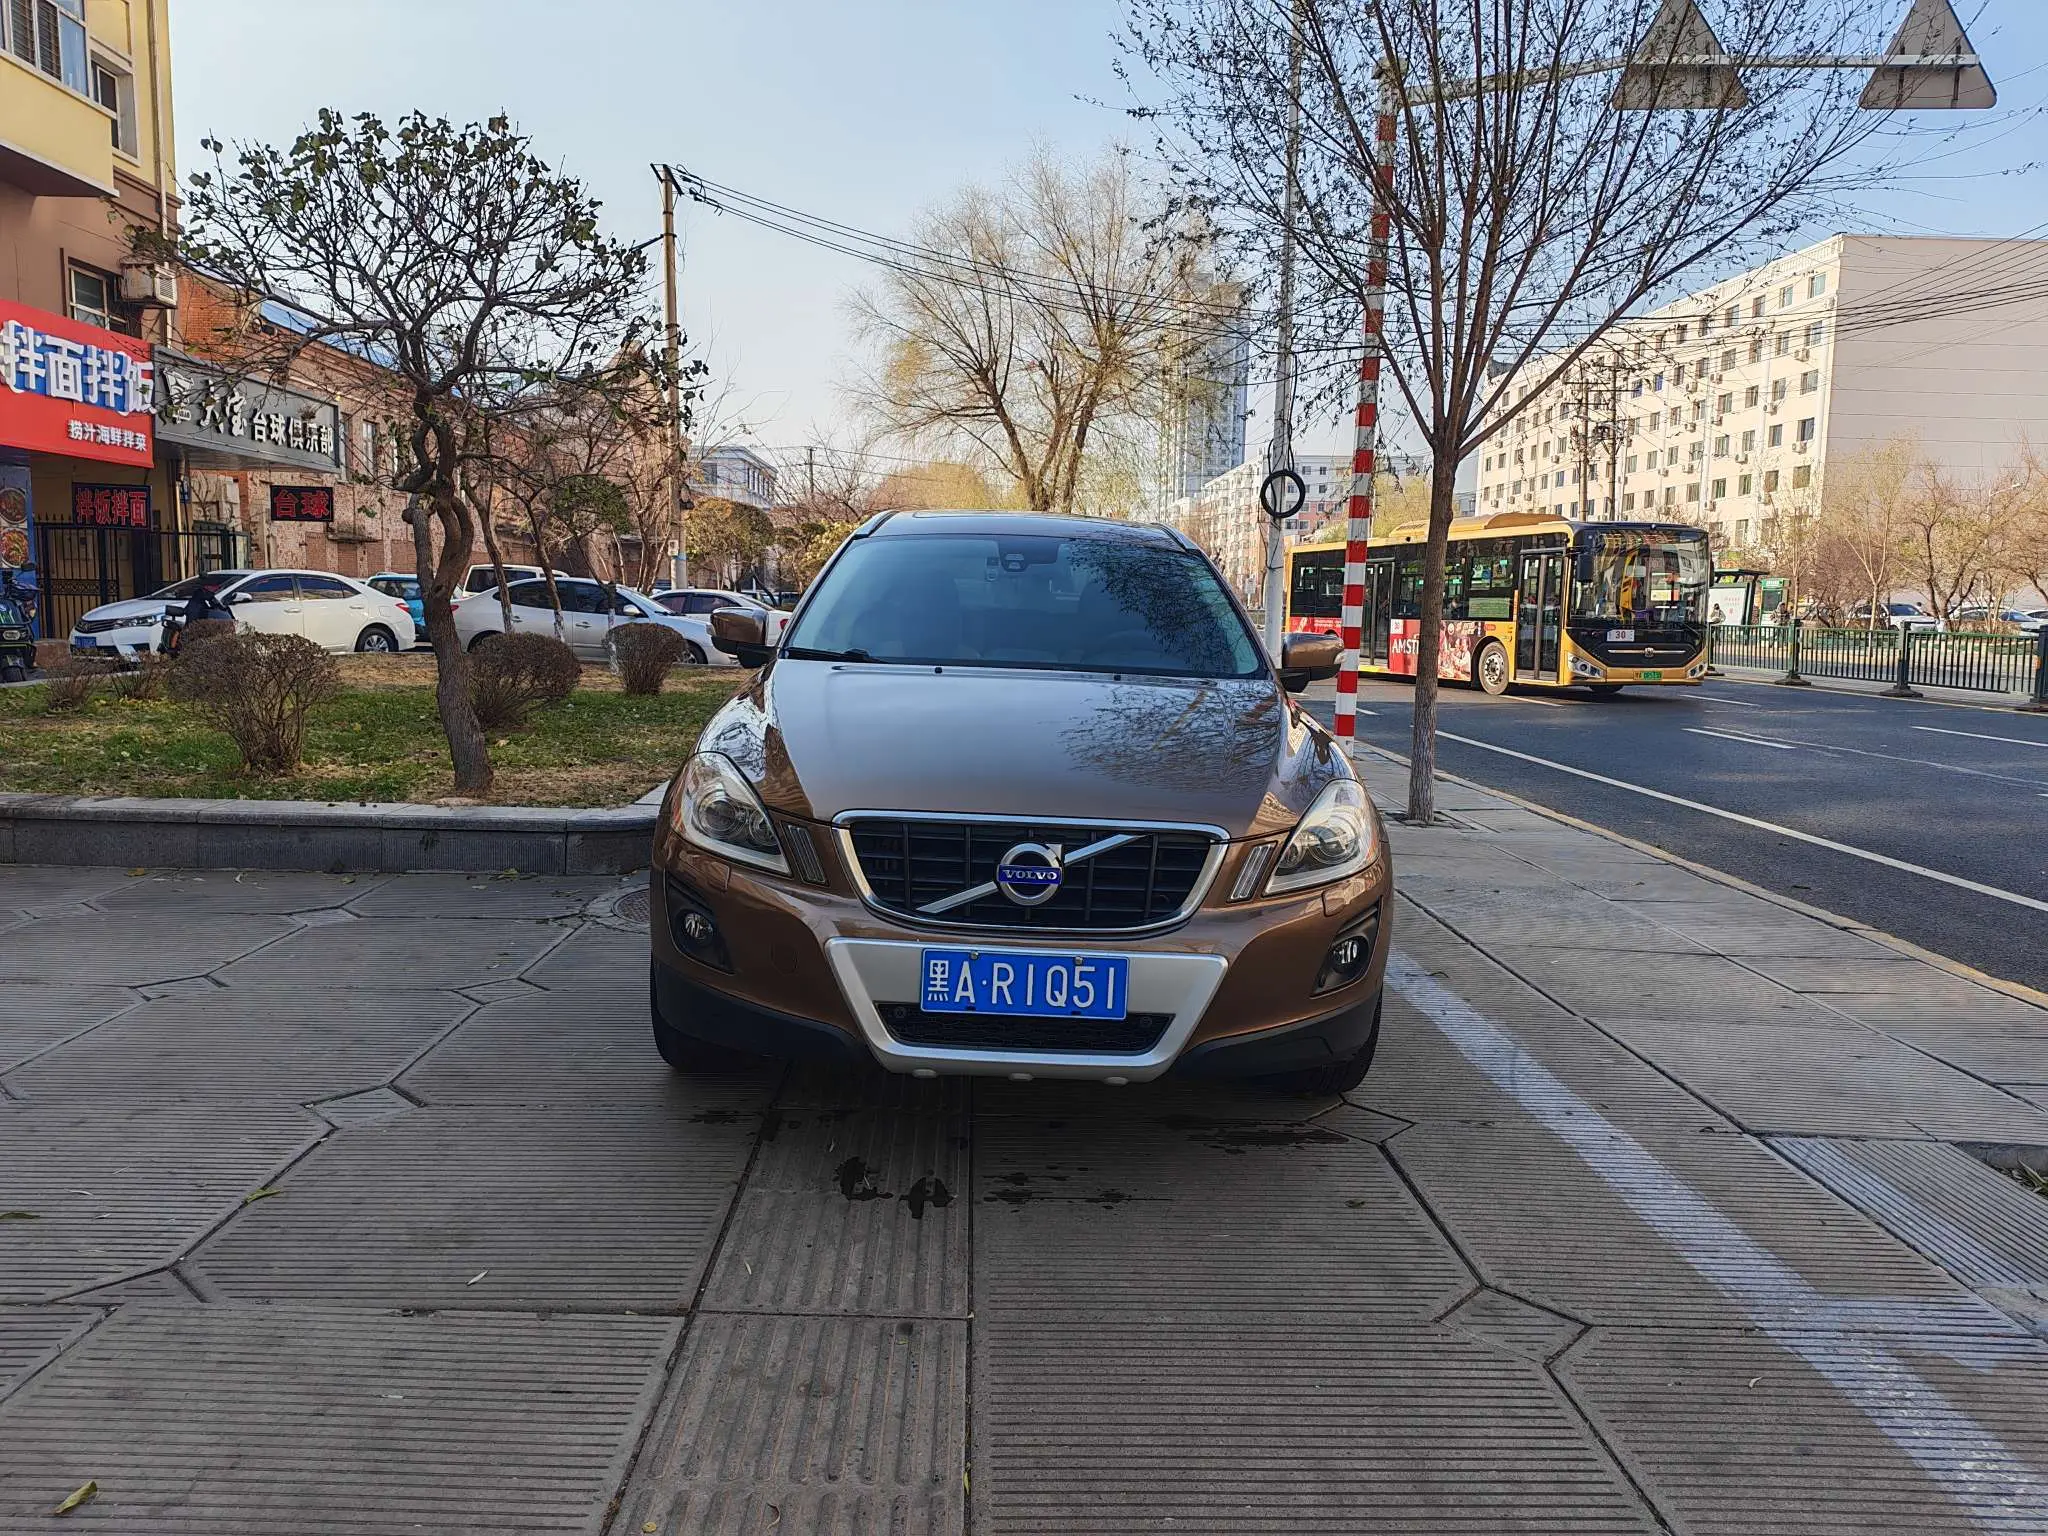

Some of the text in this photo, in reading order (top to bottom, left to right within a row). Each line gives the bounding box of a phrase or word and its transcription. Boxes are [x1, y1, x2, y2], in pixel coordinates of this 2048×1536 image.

[1, 320, 157, 415] 拌面拌饭
[76, 487, 148, 527] 拌饭拌面
[273, 489, 331, 519] 台球
[1391, 638, 1420, 655] AMST
[1615, 630, 1626, 639] 30
[1002, 868, 1058, 881] VOLVO
[927, 959, 1116, 1010] 黑A·R1Q51
